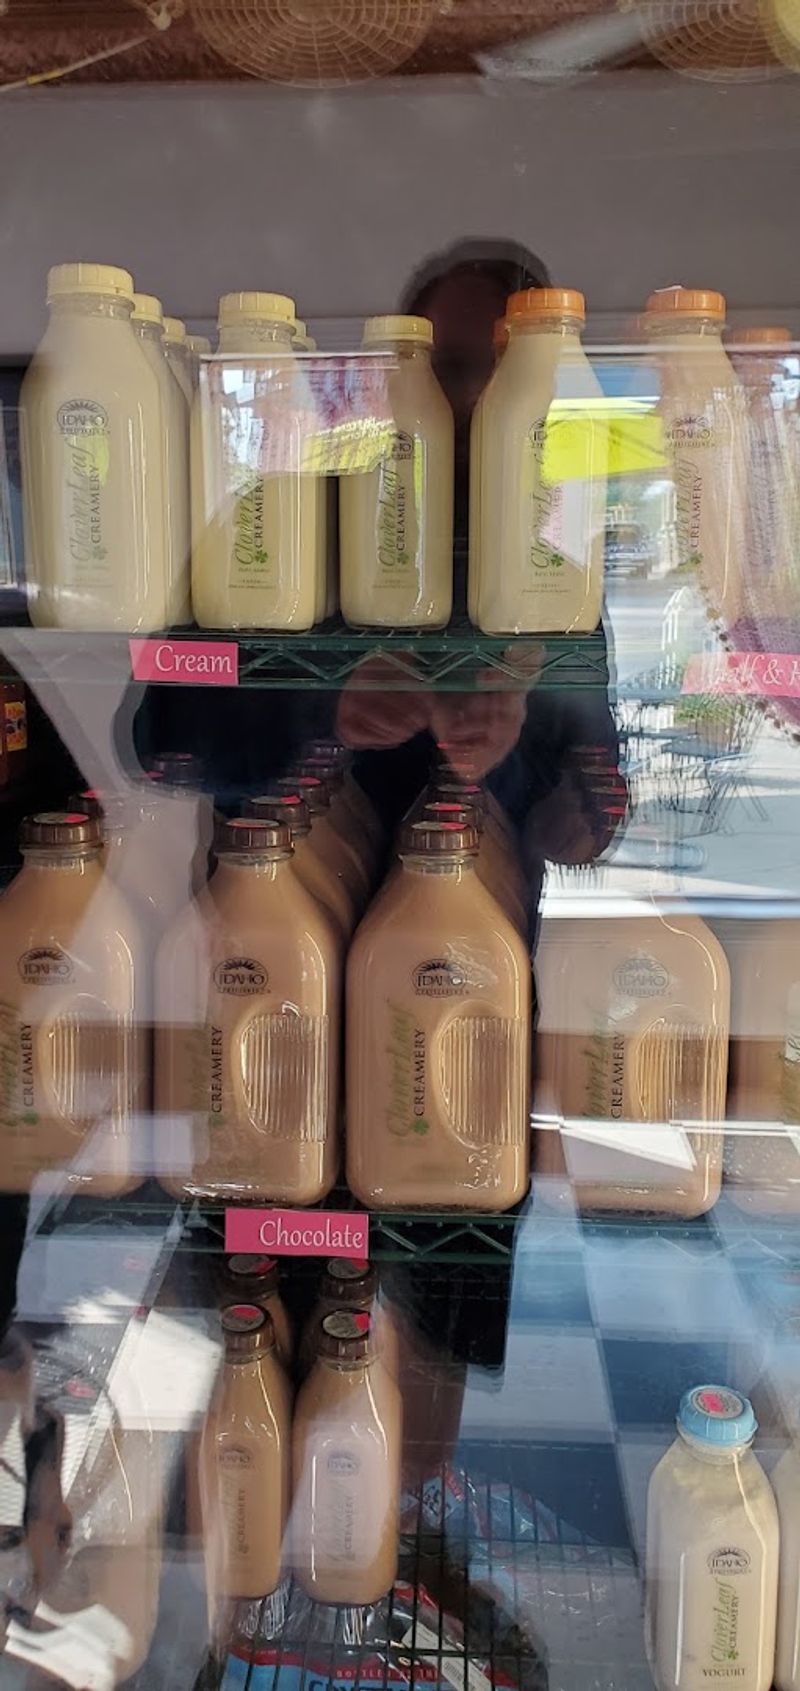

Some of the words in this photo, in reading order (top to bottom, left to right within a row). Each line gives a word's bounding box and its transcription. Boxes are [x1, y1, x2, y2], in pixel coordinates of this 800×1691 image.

[62, 414, 105, 427] IDAHO
[64, 436, 97, 563] CloverLeaf
[89, 464, 102, 545] CREAMERY
[254, 476, 265, 550] CREAMERY
[378, 461, 399, 567] CloverLeaf
[396, 484, 406, 552] CREAMERY
[690, 475, 703, 549] CREAMERY
[155, 645, 233, 673] Cream
[762, 658, 784, 685] &
[23, 963, 70, 976] IDAHO
[219, 973, 265, 986] IDAHO
[417, 974, 464, 987] IDAHO
[617, 975, 666, 988] IDAHO
[20, 1022, 35, 1107] CREAMERY
[211, 1026, 224, 1114] CREAMERY
[413, 1028, 426, 1117] CREAMERY
[610, 1031, 626, 1120] CREAMERY
[259, 1217, 364, 1249] Chocolate
[711, 1558, 748, 1568] IDAHO
[711, 1576, 737, 1662] CloverLeaf
[729, 1595, 740, 1649] CREAMERY
[702, 1667, 746, 1678] YOGURT
